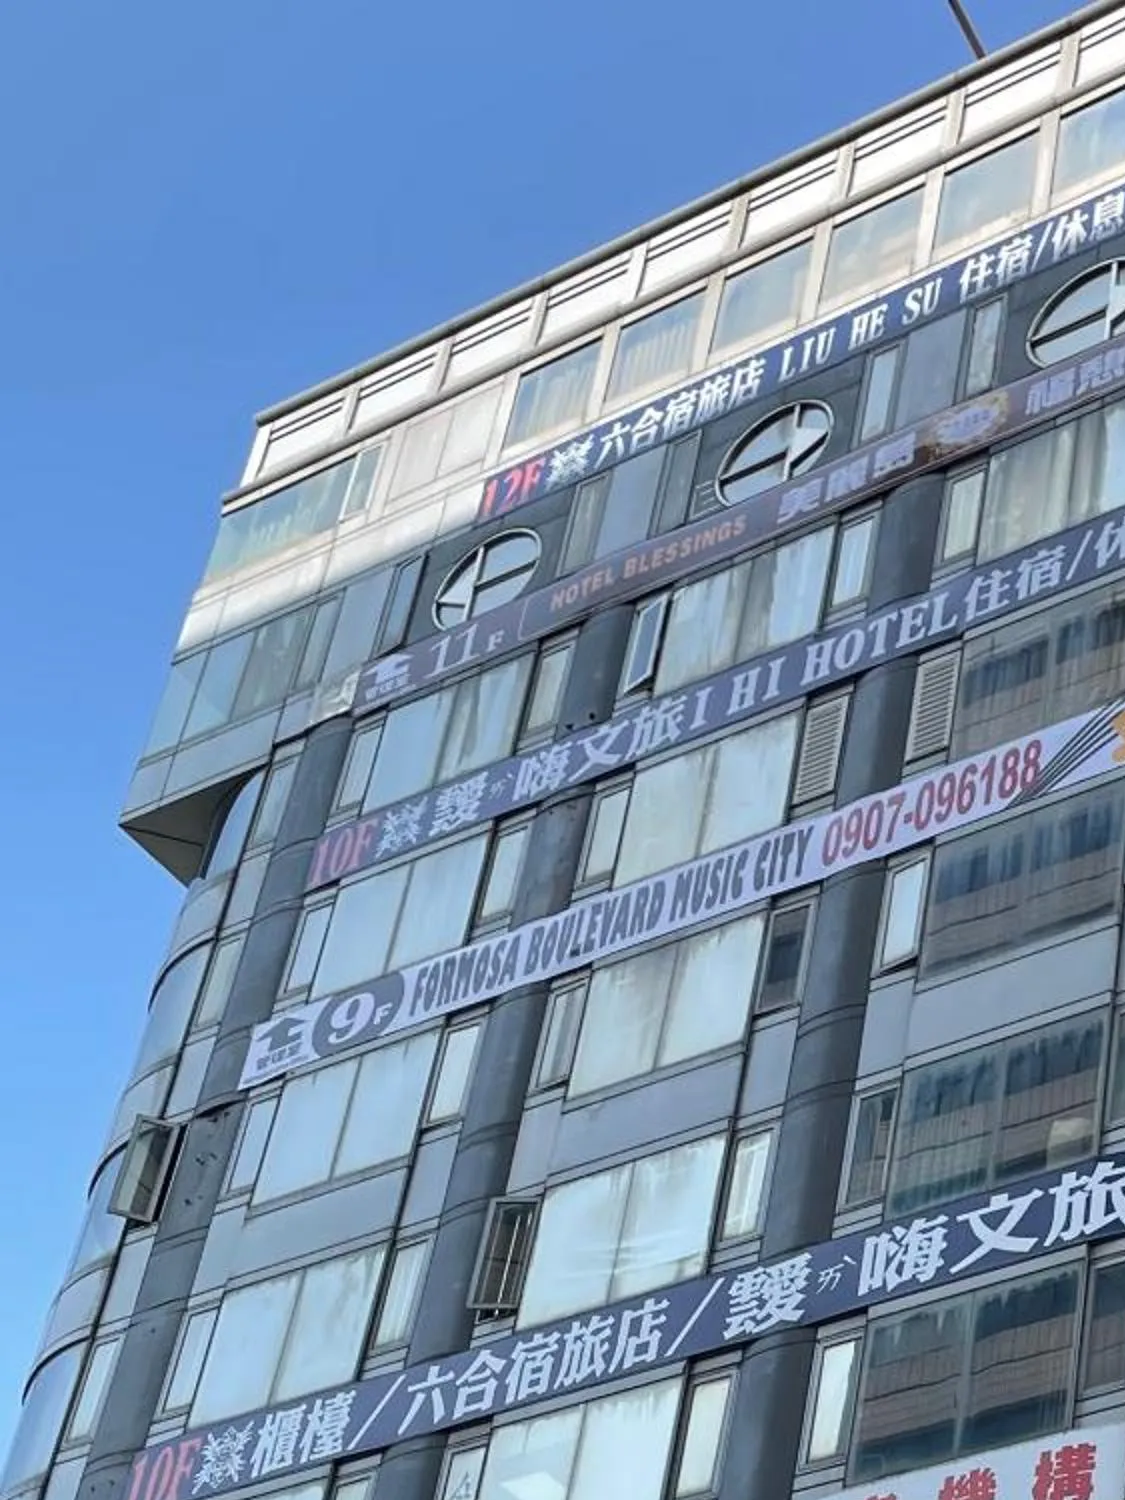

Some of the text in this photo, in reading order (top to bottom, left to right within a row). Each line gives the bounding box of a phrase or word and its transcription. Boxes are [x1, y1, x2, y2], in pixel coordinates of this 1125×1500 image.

[479, 458, 547, 518] 12F
[598, 359, 765, 467] 六合宿旅店
[779, 329, 833, 379] LIU
[850, 304, 888, 346] HE
[902, 278, 942, 326] SU
[550, 567, 615, 613] HOTEL
[622, 514, 748, 577] BLESSINGS
[308, 817, 378, 889] 10F
[728, 658, 787, 717] HI
[800, 590, 963, 690] HOTEL
[409, 942, 520, 1017] FORMOSA
[524, 881, 667, 973] BOULEVARD
[670, 848, 748, 923] MUSIC
[753, 825, 814, 891] CITY
[821, 738, 1043, 867] 0907-096188
